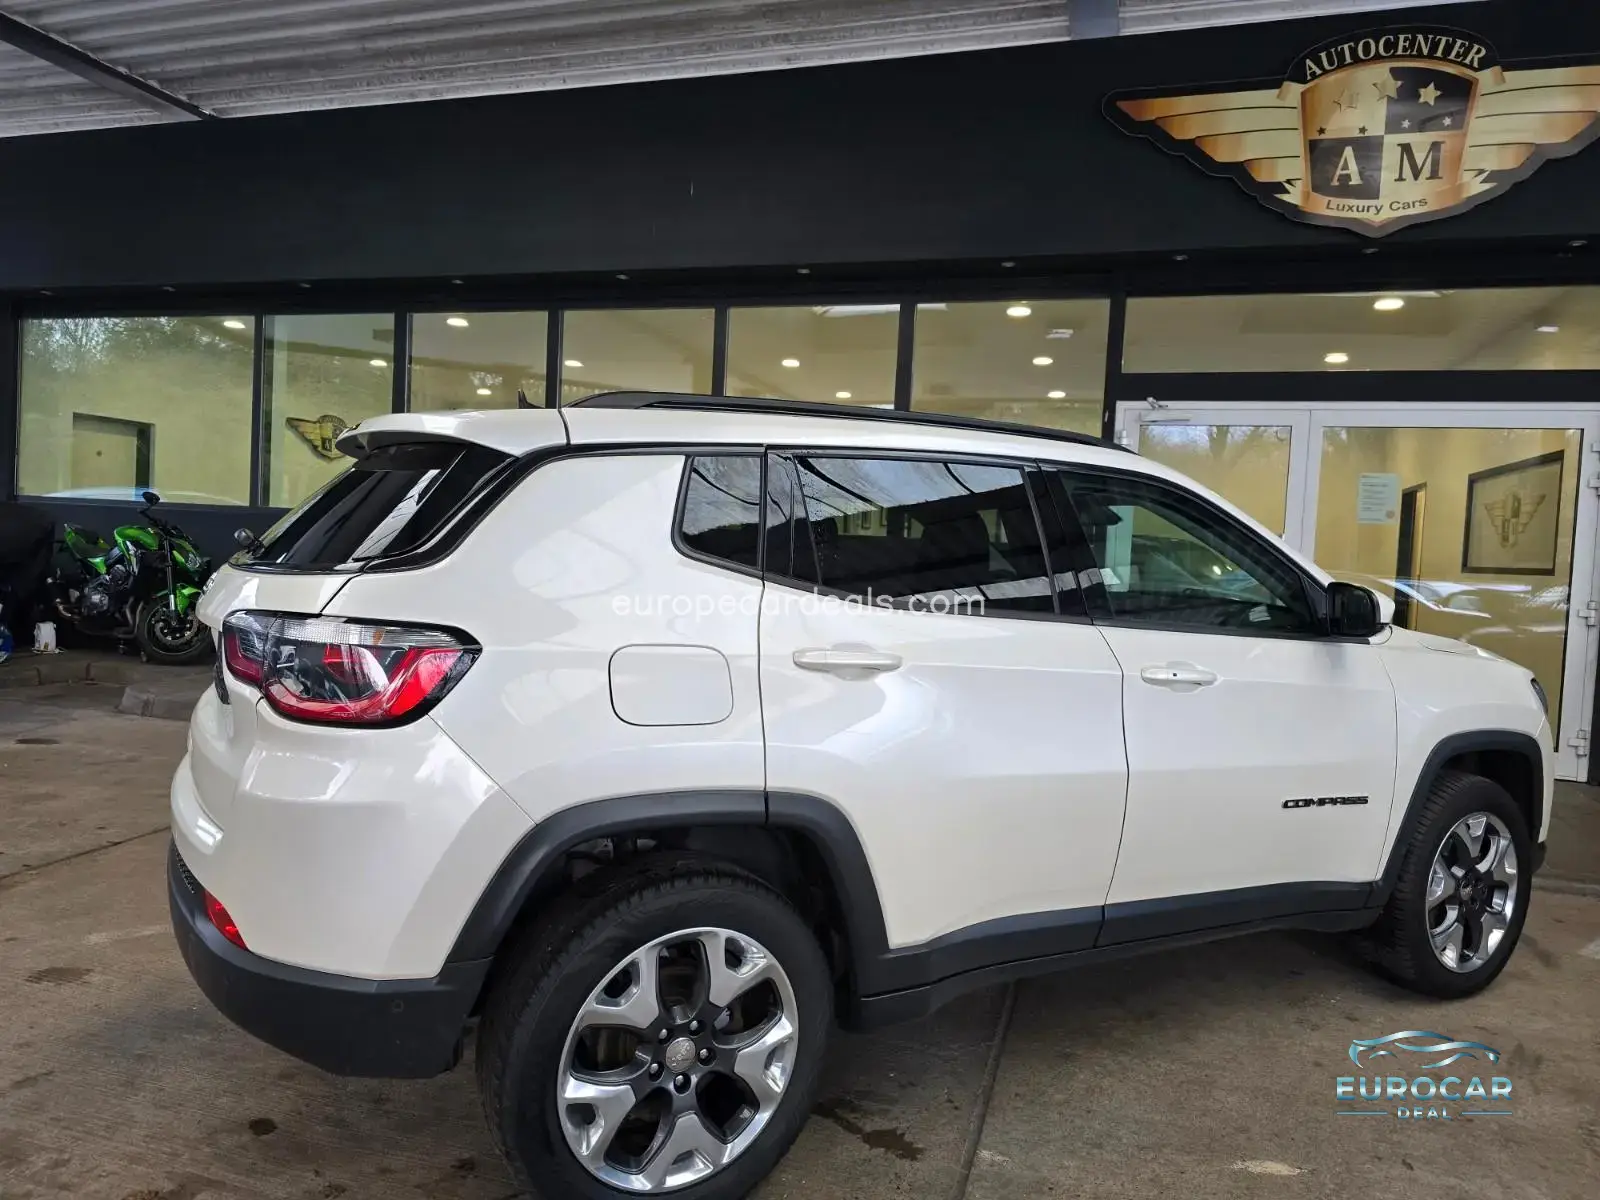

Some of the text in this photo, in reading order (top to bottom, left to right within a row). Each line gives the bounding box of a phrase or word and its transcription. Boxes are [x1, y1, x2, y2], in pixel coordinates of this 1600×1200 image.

[1304, 33, 1487, 81] AUTOCENTER
[1330, 140, 1446, 186] A M
[1325, 198, 1429, 215] Luxury Cars
[1281, 795, 1369, 809] COMPASS
